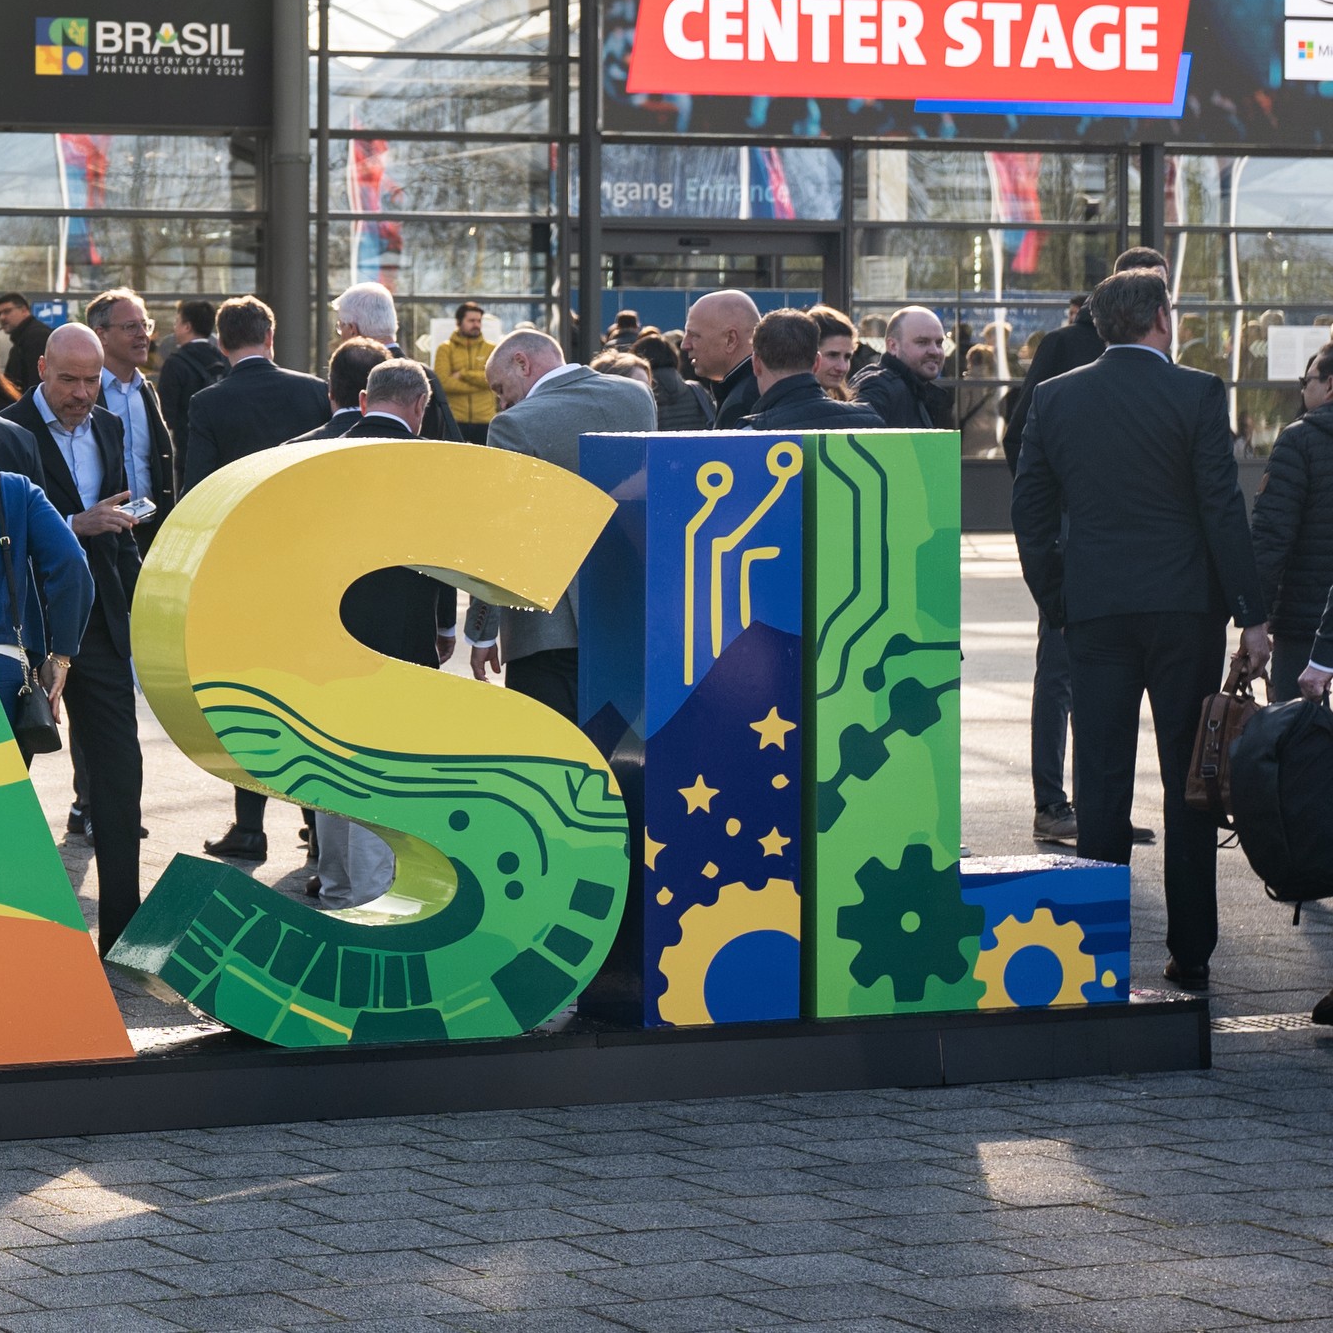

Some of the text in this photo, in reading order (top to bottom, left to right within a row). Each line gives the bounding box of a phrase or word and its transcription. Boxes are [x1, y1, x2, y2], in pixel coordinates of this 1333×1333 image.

[95, 21, 245, 56] BRASIL
[943, 0, 1159, 71] STAGE
[95, 66, 245, 76] PARTNER COUNTRY 2026
[96, 56, 116, 64] THE
[122, 56, 181, 65] INDUSTRY
[207, 58, 244, 66] TODAY
[685, 176, 790, 204] Entrance
